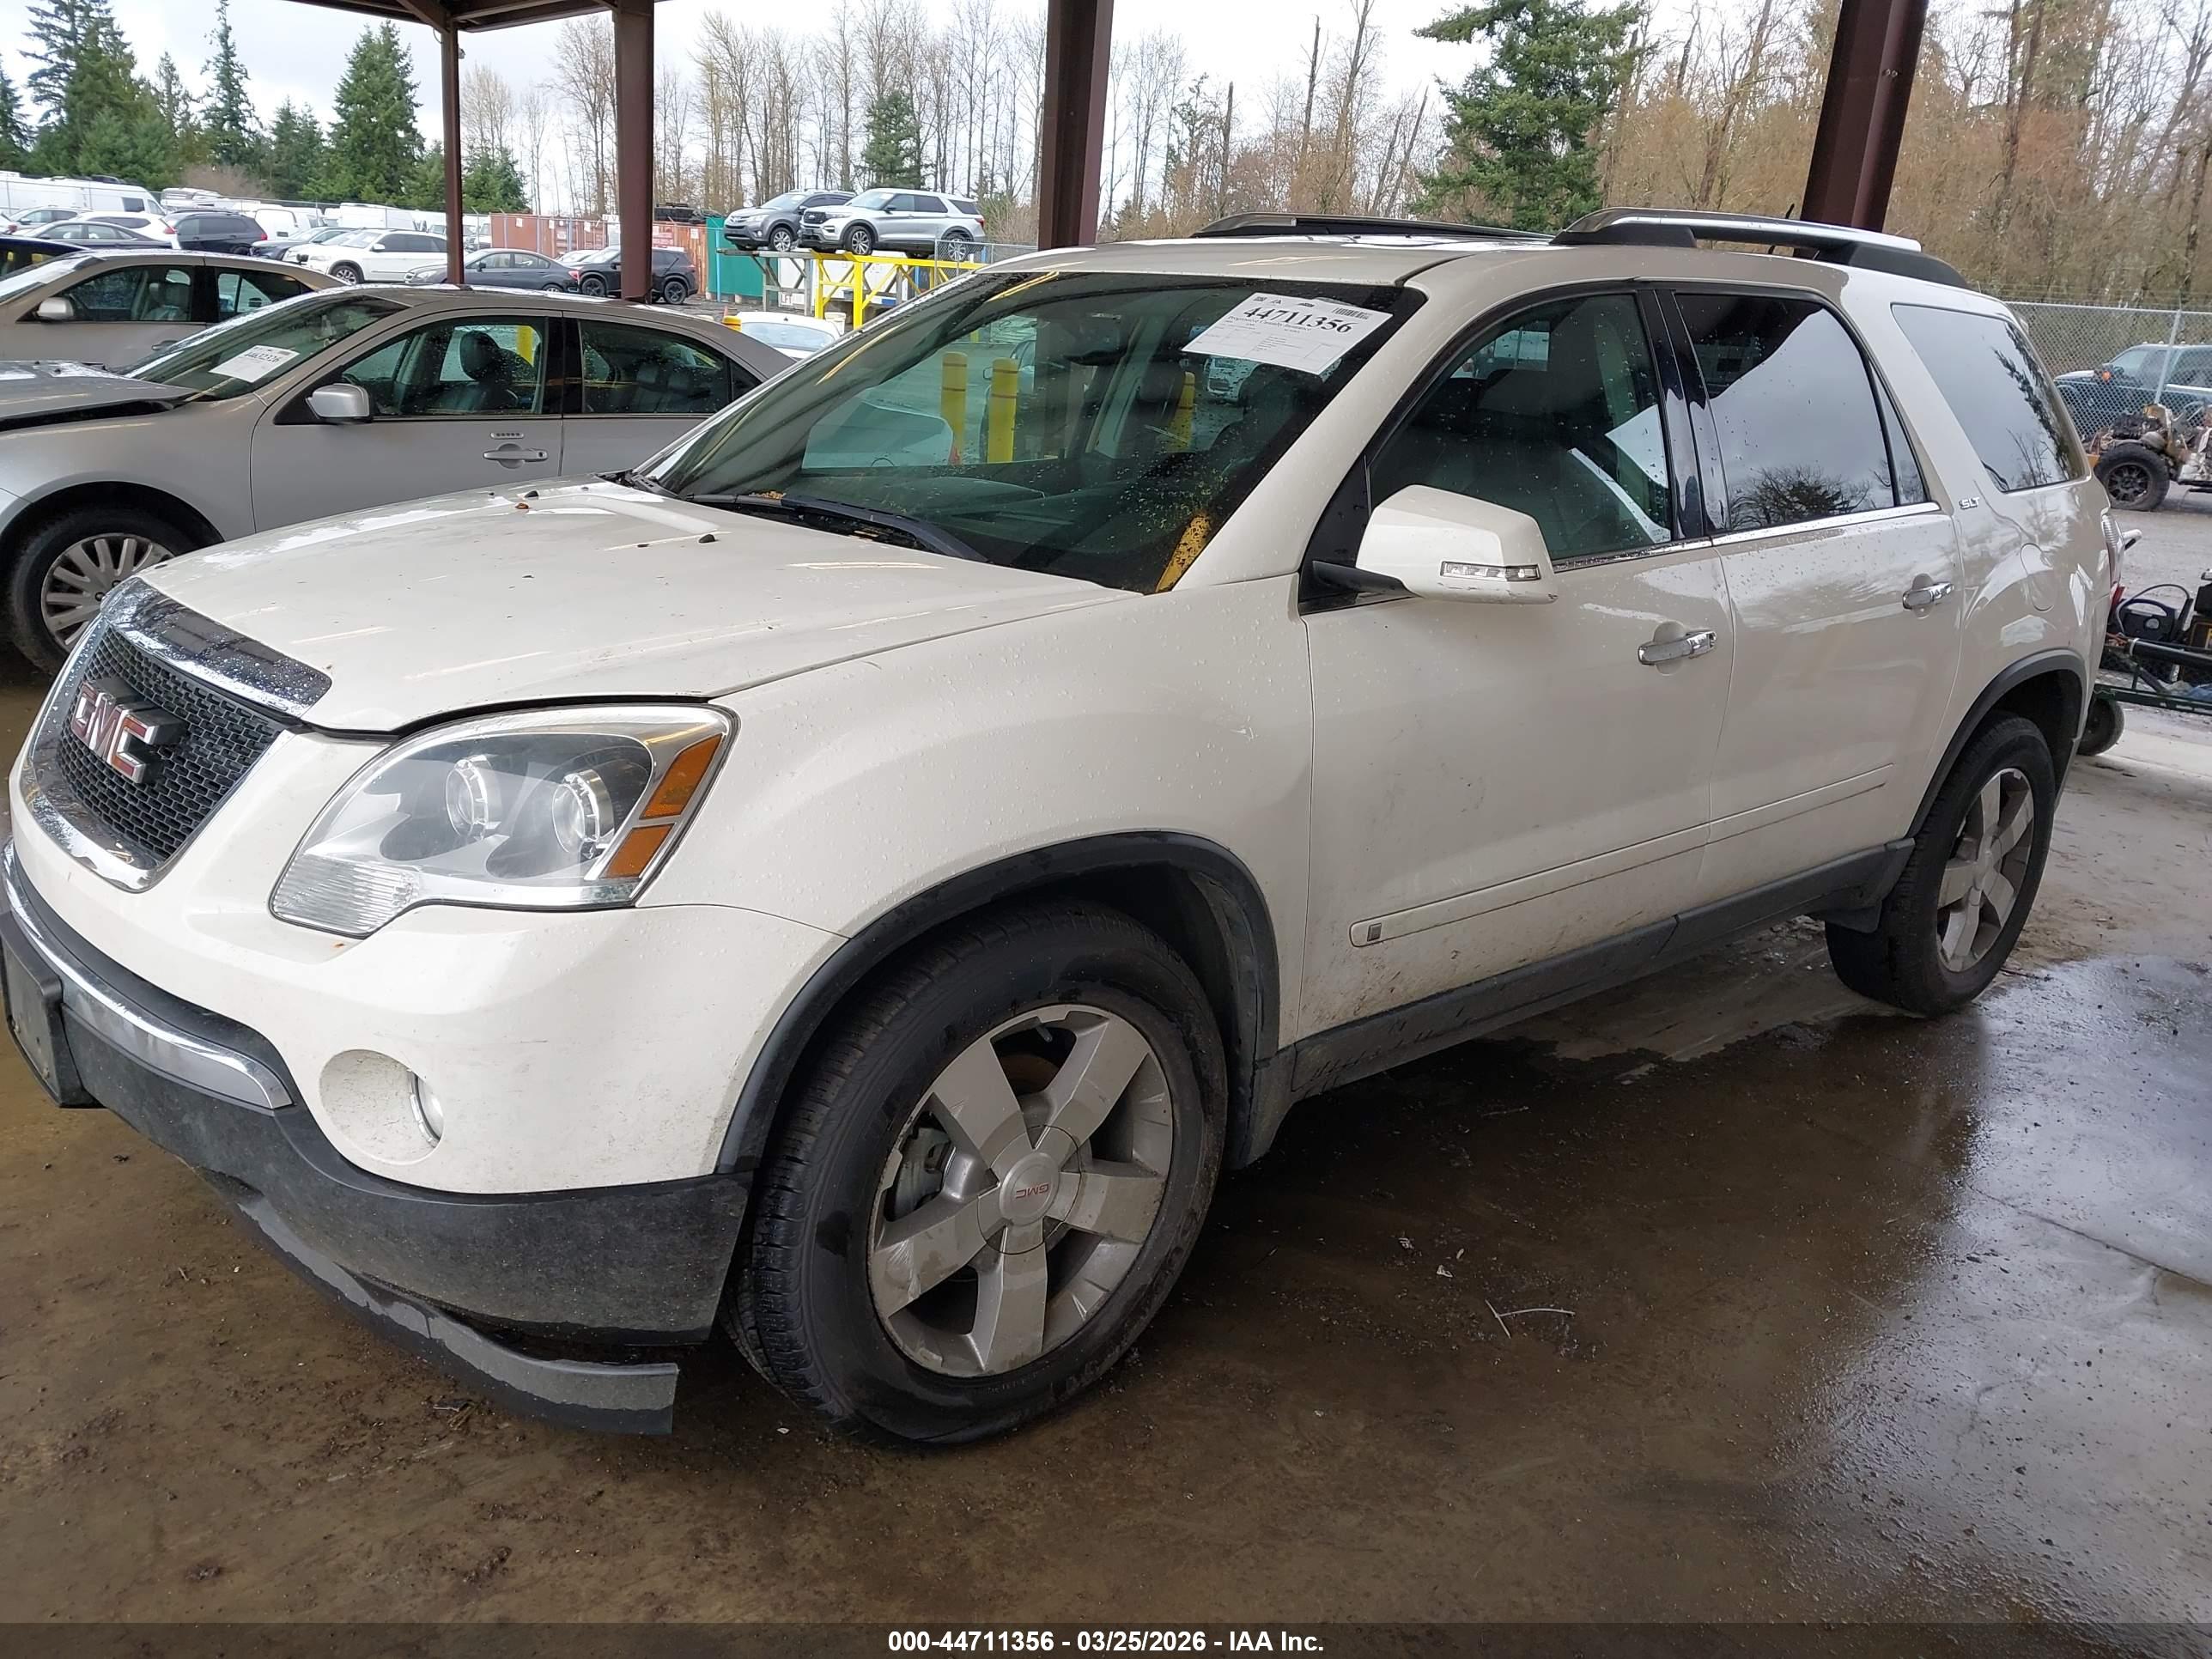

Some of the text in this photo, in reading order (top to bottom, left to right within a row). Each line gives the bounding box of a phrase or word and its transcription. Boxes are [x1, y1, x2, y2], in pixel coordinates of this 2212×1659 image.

[1244, 307, 1358, 333] 44711356
[1959, 497, 1980, 510] SLT
[70, 681, 159, 784] GMC
[1016, 1184, 1049, 1199] GMC
